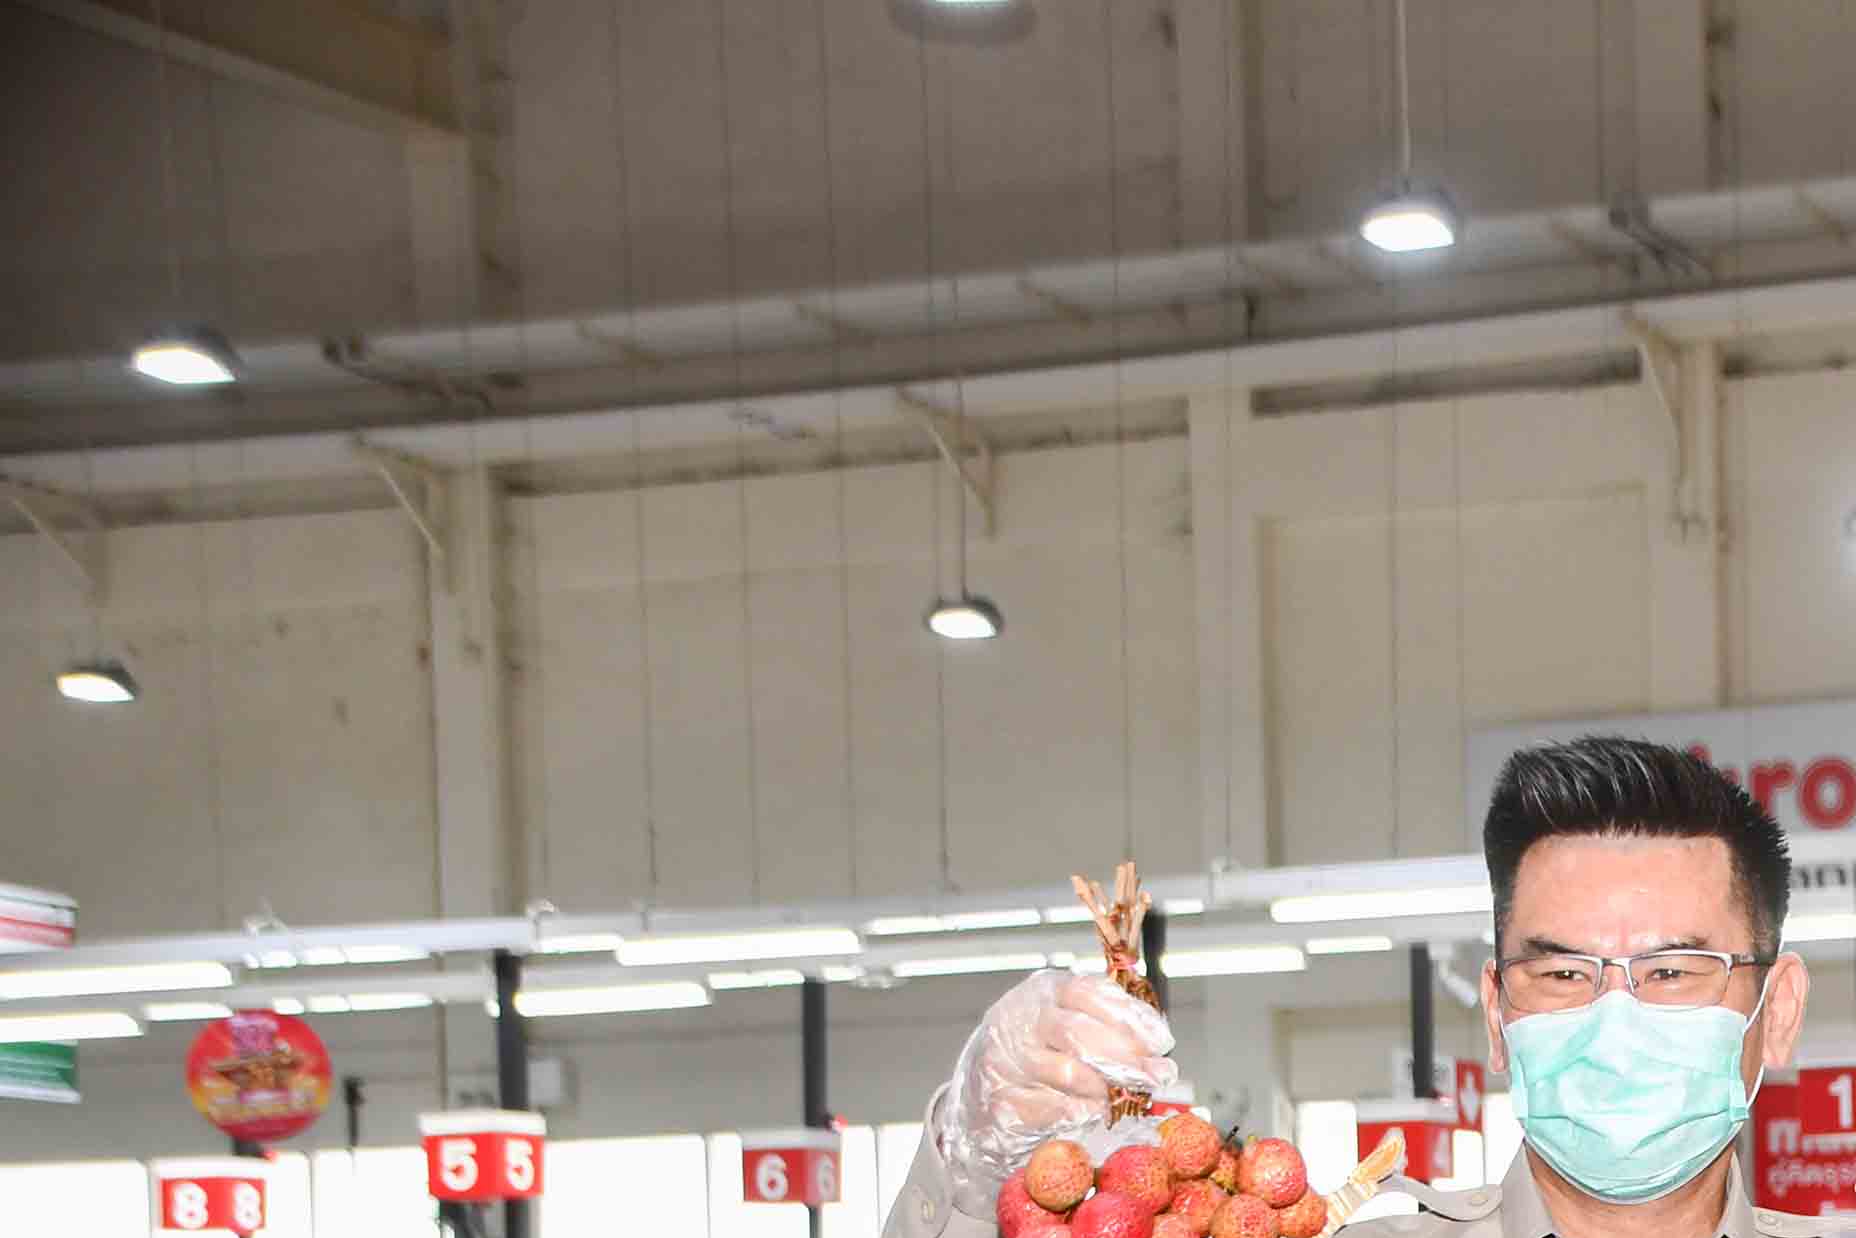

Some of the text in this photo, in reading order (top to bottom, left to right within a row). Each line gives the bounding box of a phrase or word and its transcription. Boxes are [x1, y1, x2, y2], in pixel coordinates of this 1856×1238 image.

[1828, 1074, 1854, 1128] 1
[442, 1138, 535, 1191] 5 5
[756, 1153, 788, 1200] 6
[173, 1182, 261, 1229] 8 8
